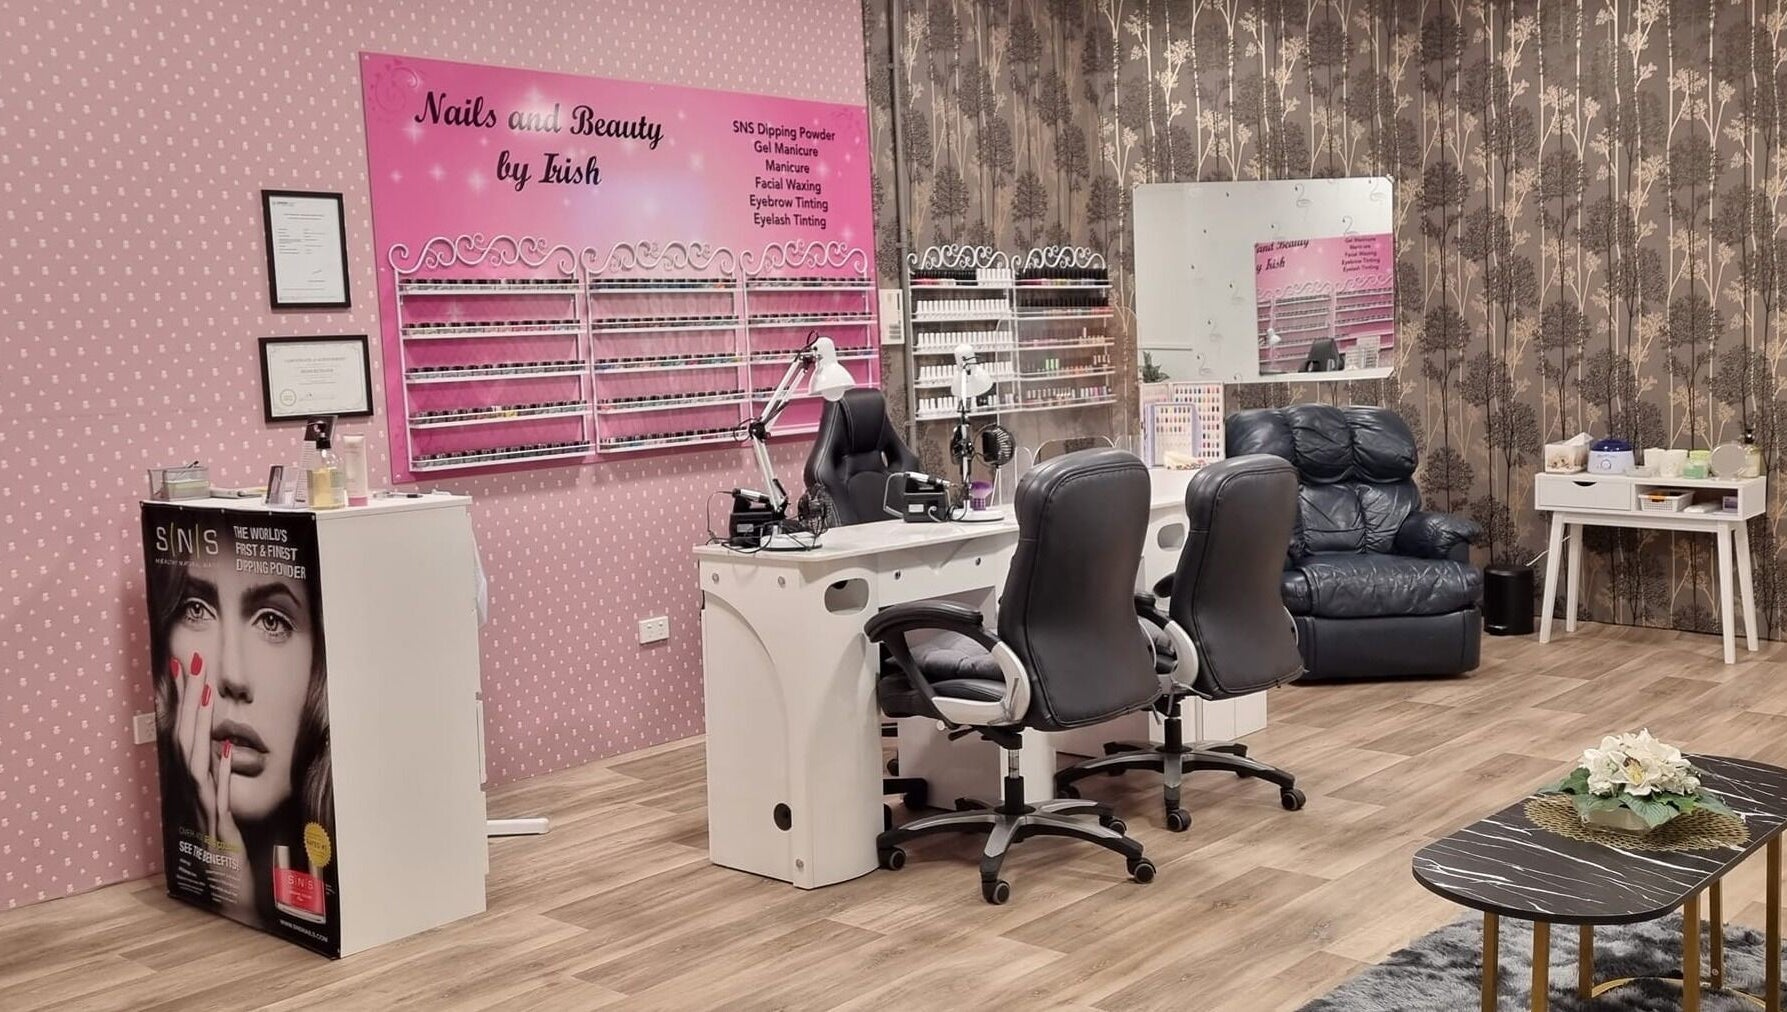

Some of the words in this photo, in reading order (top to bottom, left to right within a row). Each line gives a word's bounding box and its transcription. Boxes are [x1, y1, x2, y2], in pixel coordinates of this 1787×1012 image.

[414, 91, 497, 128] Nails
[508, 103, 562, 133] and
[570, 105, 664, 150] Beauty
[733, 120, 754, 134] SNS
[758, 123, 797, 141] Dipping
[799, 127, 835, 141] Powder
[754, 140, 771, 153] Gel
[774, 142, 818, 157] Manicure
[496, 150, 531, 192] by
[538, 152, 602, 185] Irish
[765, 159, 810, 174] Manicure
[755, 176, 783, 189] Facial
[786, 178, 822, 195] Waxing
[749, 194, 793, 210] Eyebrow
[795, 196, 828, 212] Tinting
[753, 212, 791, 228] Eyelash
[793, 214, 826, 229] Tinting
[233, 525, 250, 540] THE
[250, 527, 288, 543] WORLD'S
[235, 542, 258, 557] FRST
[260, 544, 266, 557] &
[267, 545, 299, 561] FINEST
